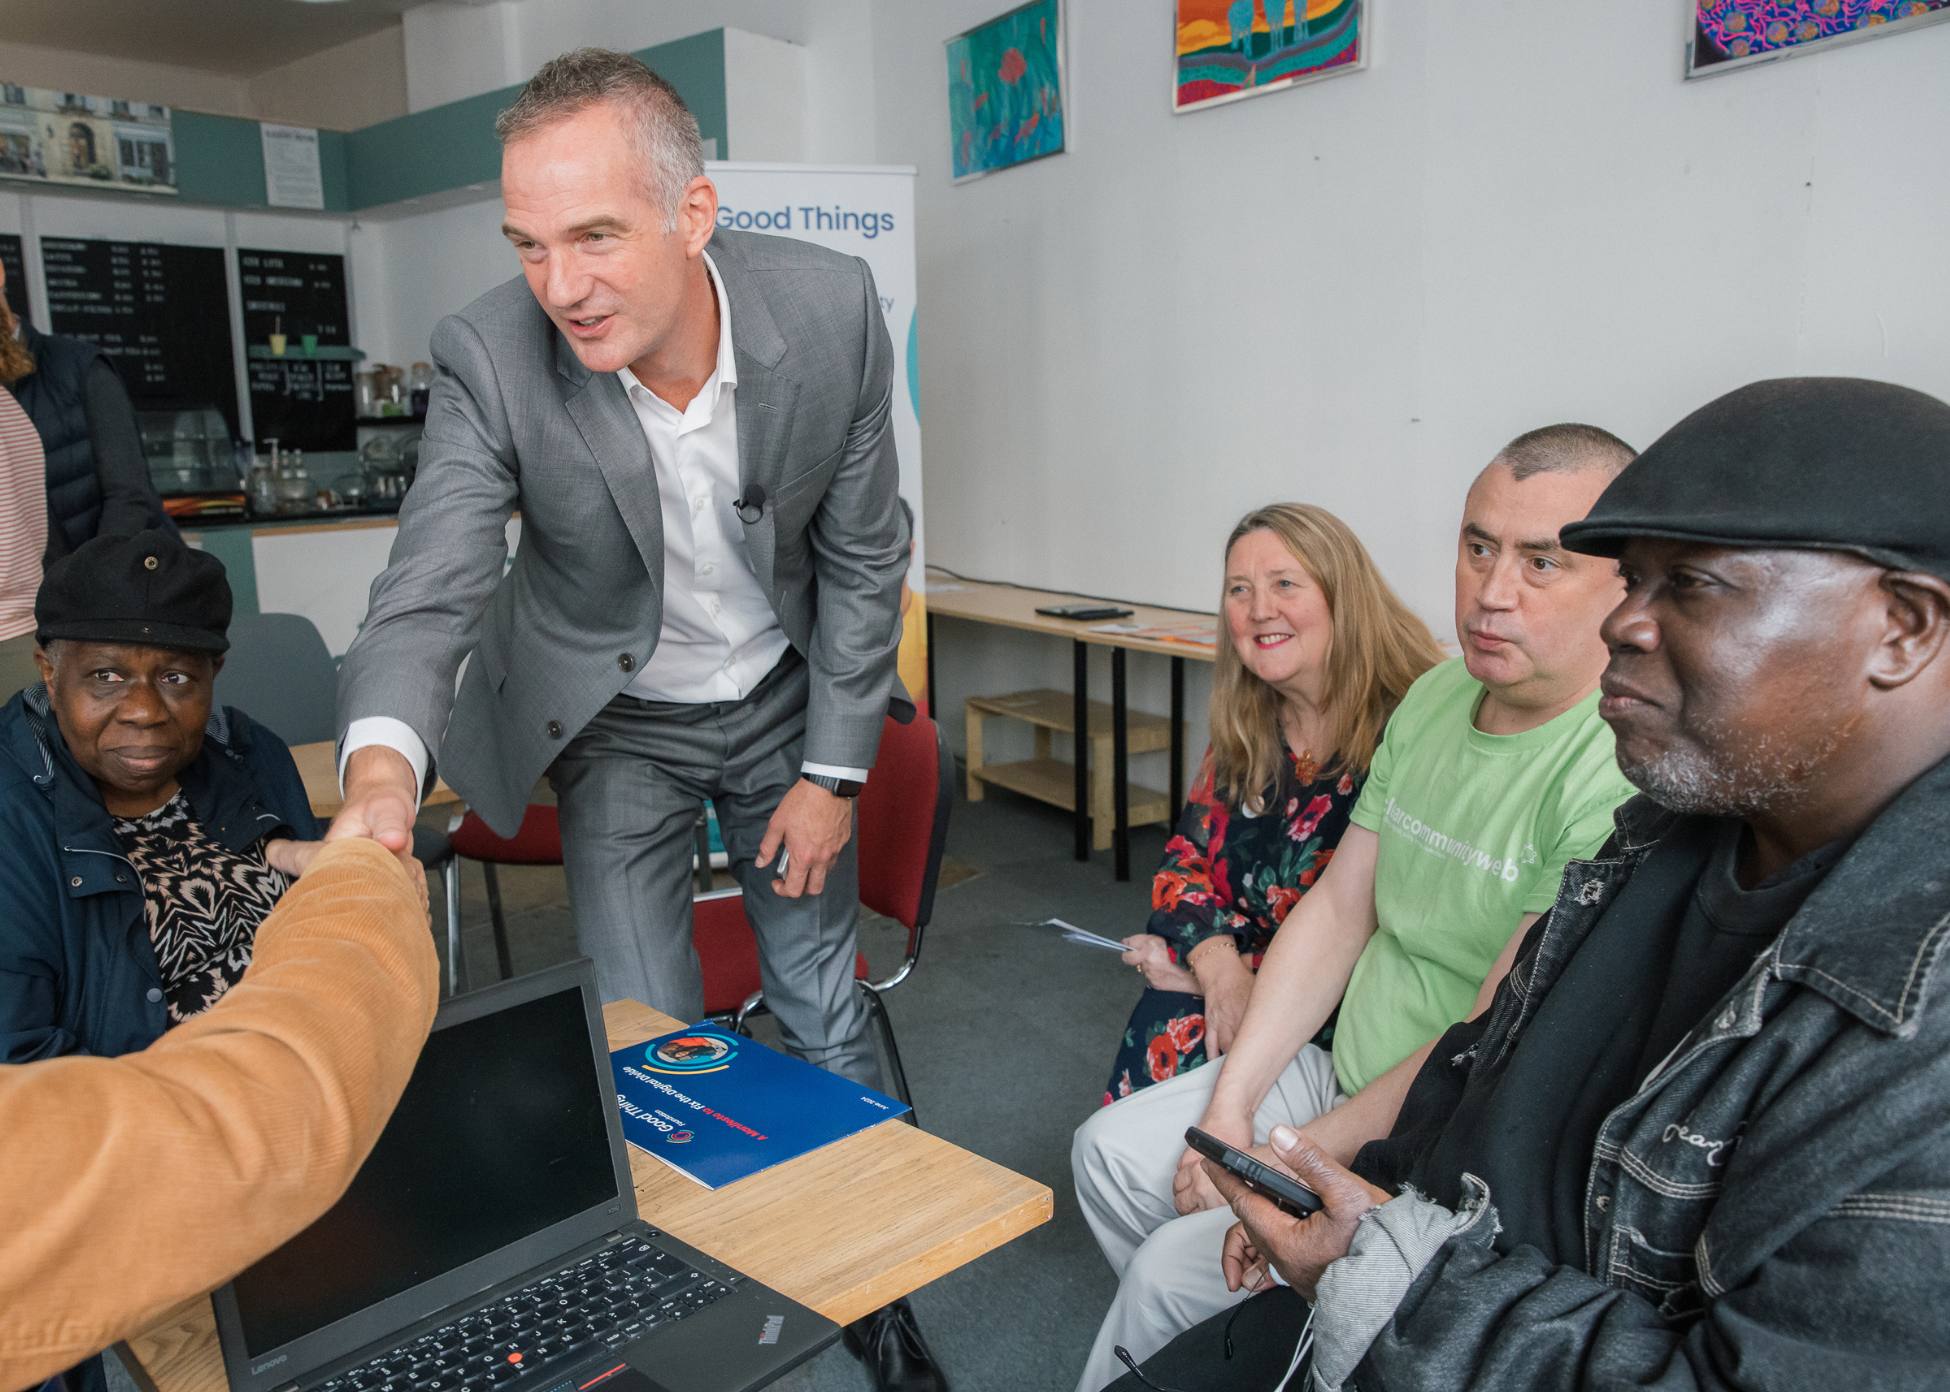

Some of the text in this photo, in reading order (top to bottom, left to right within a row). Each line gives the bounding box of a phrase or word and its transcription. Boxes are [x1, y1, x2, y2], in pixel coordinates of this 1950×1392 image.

[716, 206, 894, 239] Good Things
[622, 1066, 651, 1083] Divide
[645, 1078, 678, 1096] Digital
[674, 1092, 692, 1104] the
[688, 1100, 706, 1110] Fix
[616, 1094, 674, 1132] Good Thing
[712, 1112, 760, 1137] Manifesto
[251, 1354, 288, 1376] Lenovo
